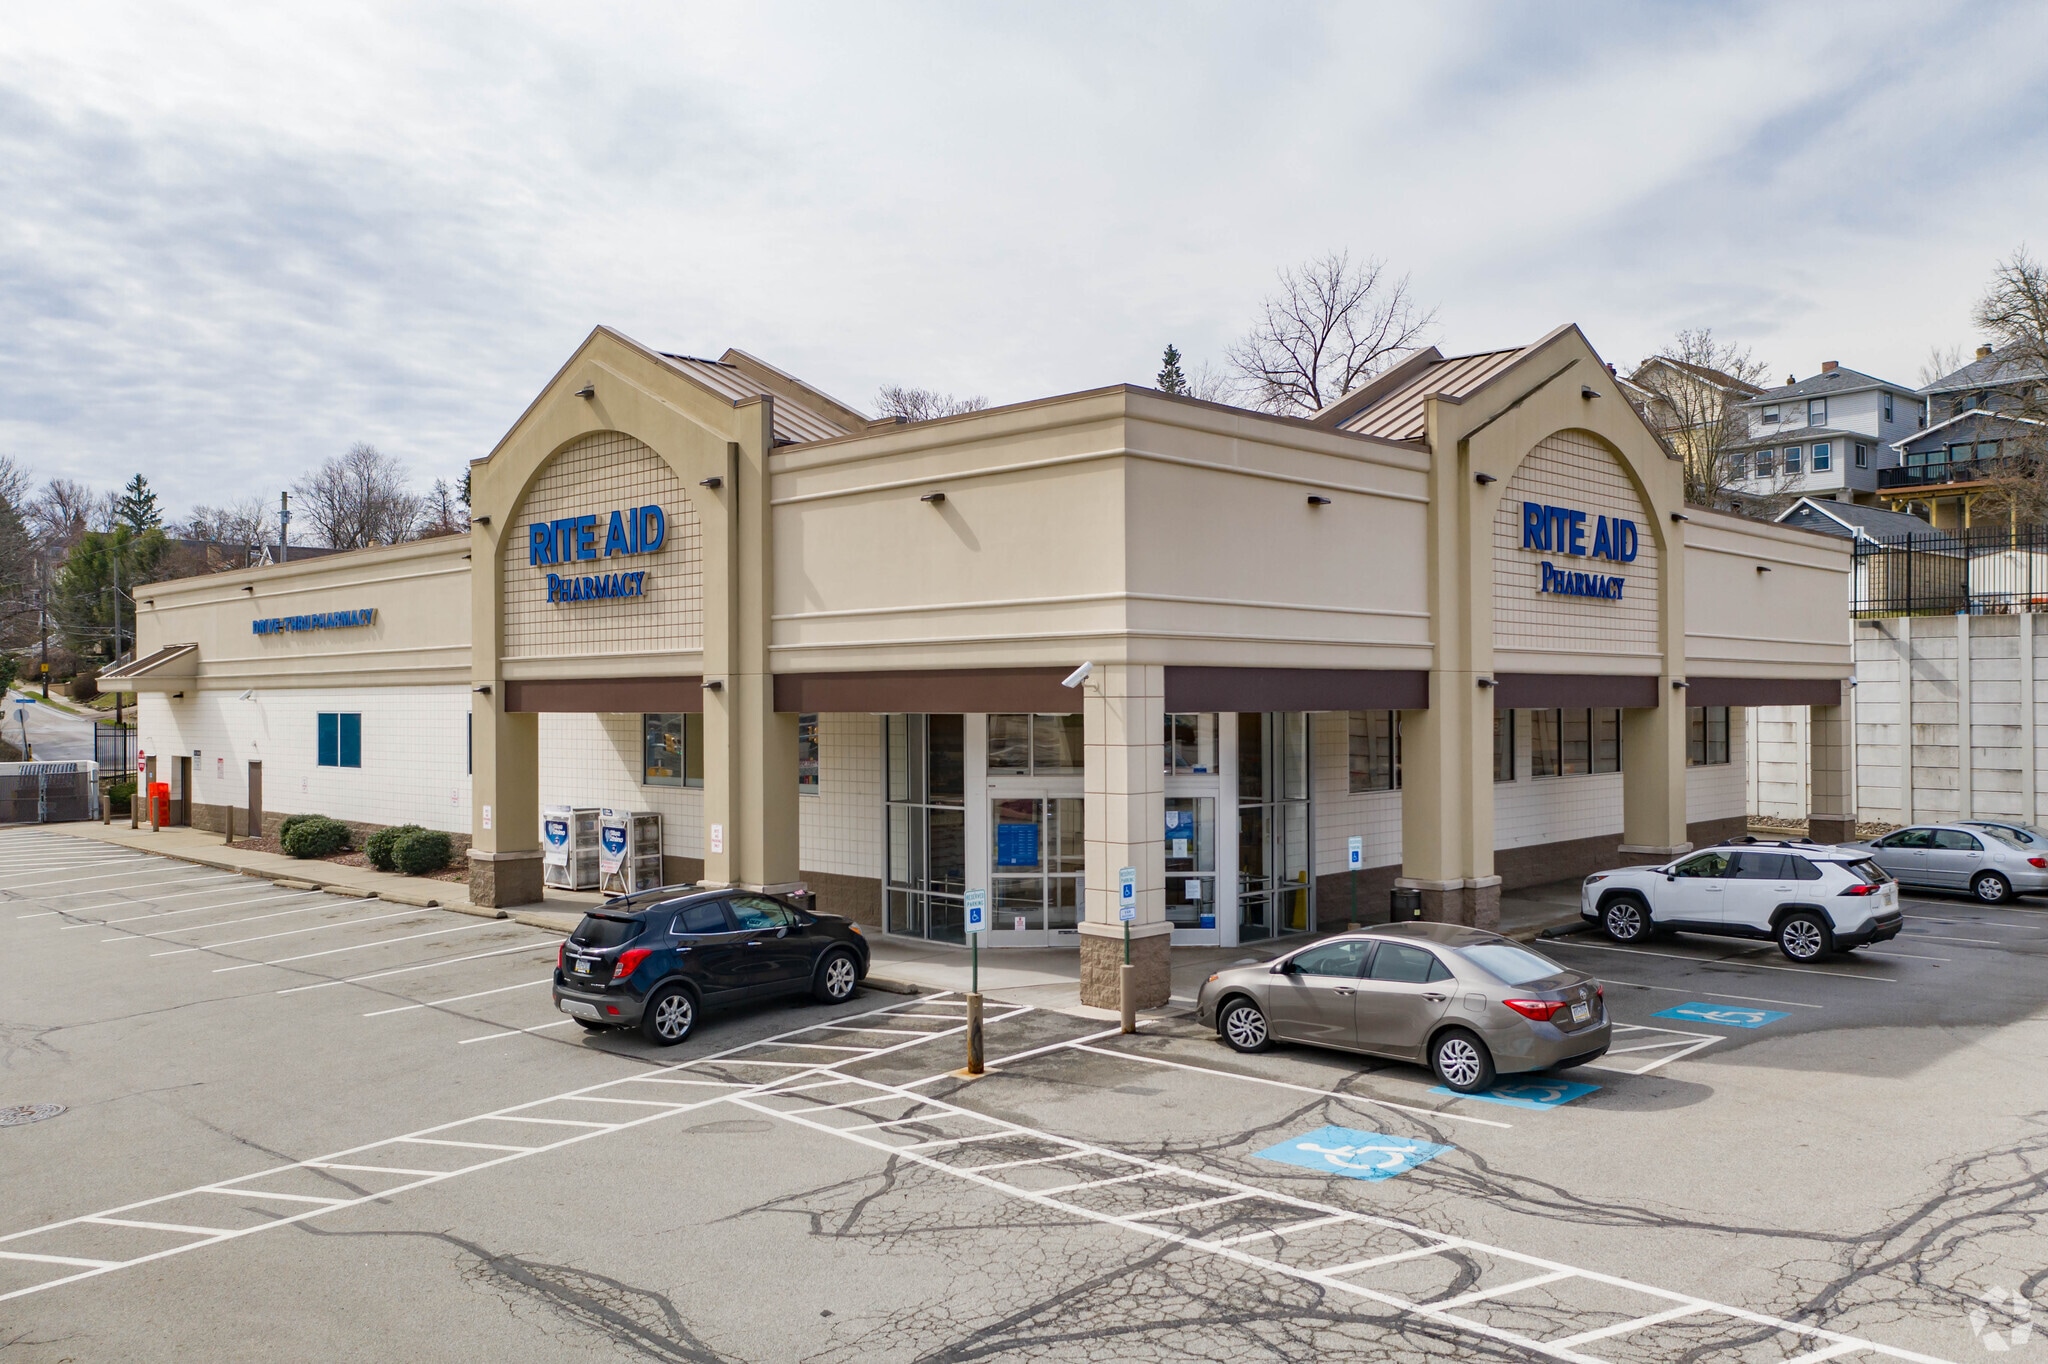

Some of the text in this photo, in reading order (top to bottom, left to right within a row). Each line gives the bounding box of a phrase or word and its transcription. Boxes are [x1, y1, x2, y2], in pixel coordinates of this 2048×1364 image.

[529, 504, 666, 566] RITE AID
[1523, 501, 1638, 563] RITE AID
[546, 571, 646, 603] PHARMACY
[1541, 561, 1625, 600] PHARMACY
[252, 608, 375, 635] DRIVE-THRU PHARMACY
